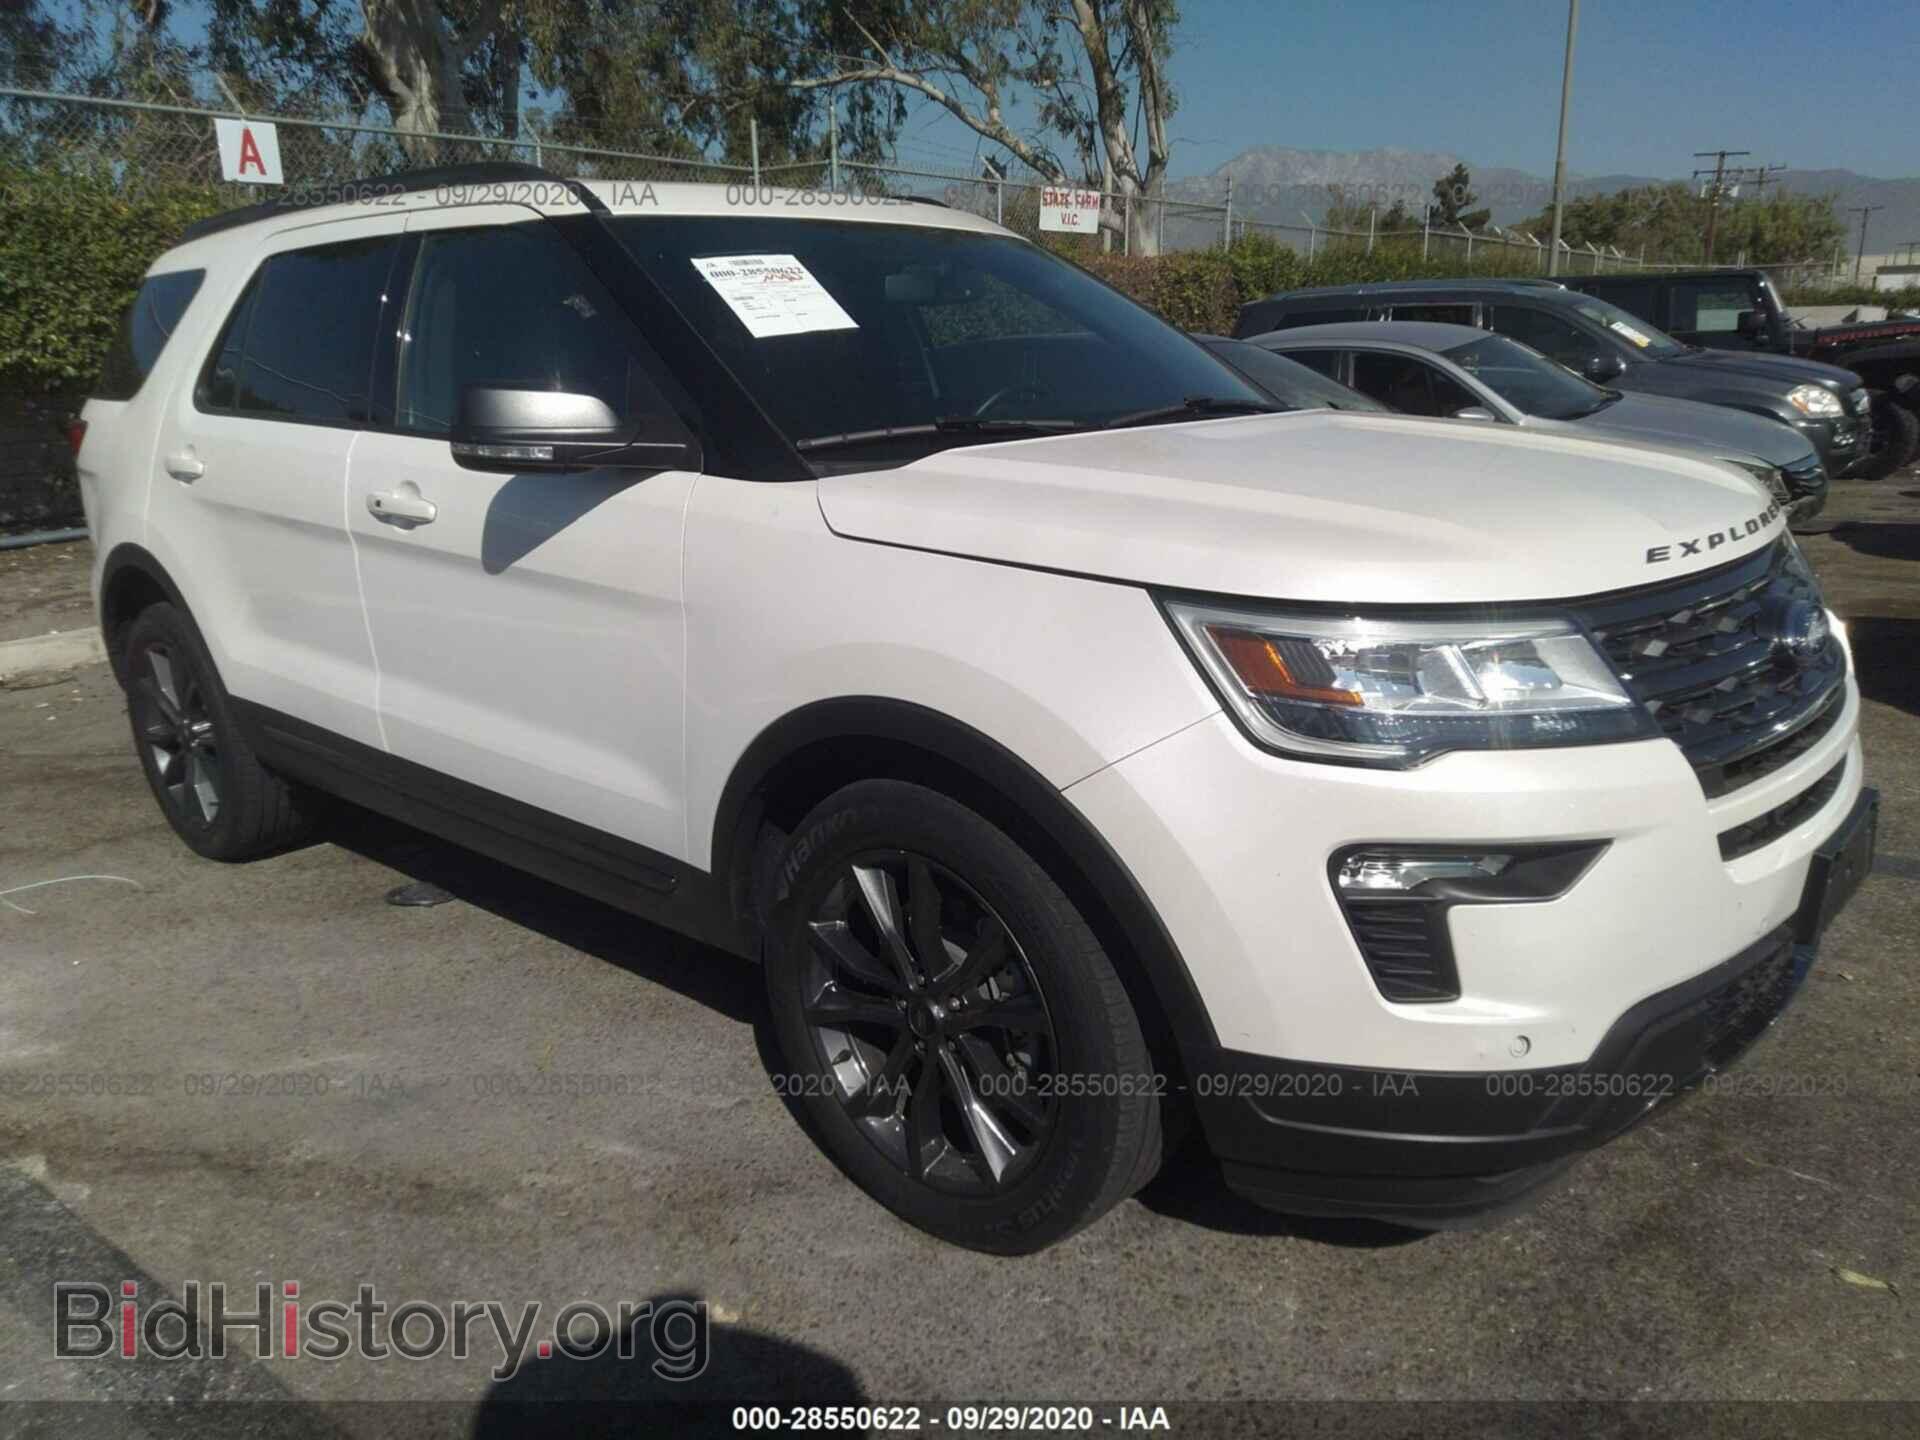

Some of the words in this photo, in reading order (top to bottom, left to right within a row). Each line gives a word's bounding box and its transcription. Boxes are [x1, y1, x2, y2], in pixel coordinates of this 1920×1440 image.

[238, 127, 266, 175] A
[1042, 191, 1072, 209] STATE
[1075, 192, 1099, 210] FARM
[1646, 501, 1779, 564] EXPLORE
